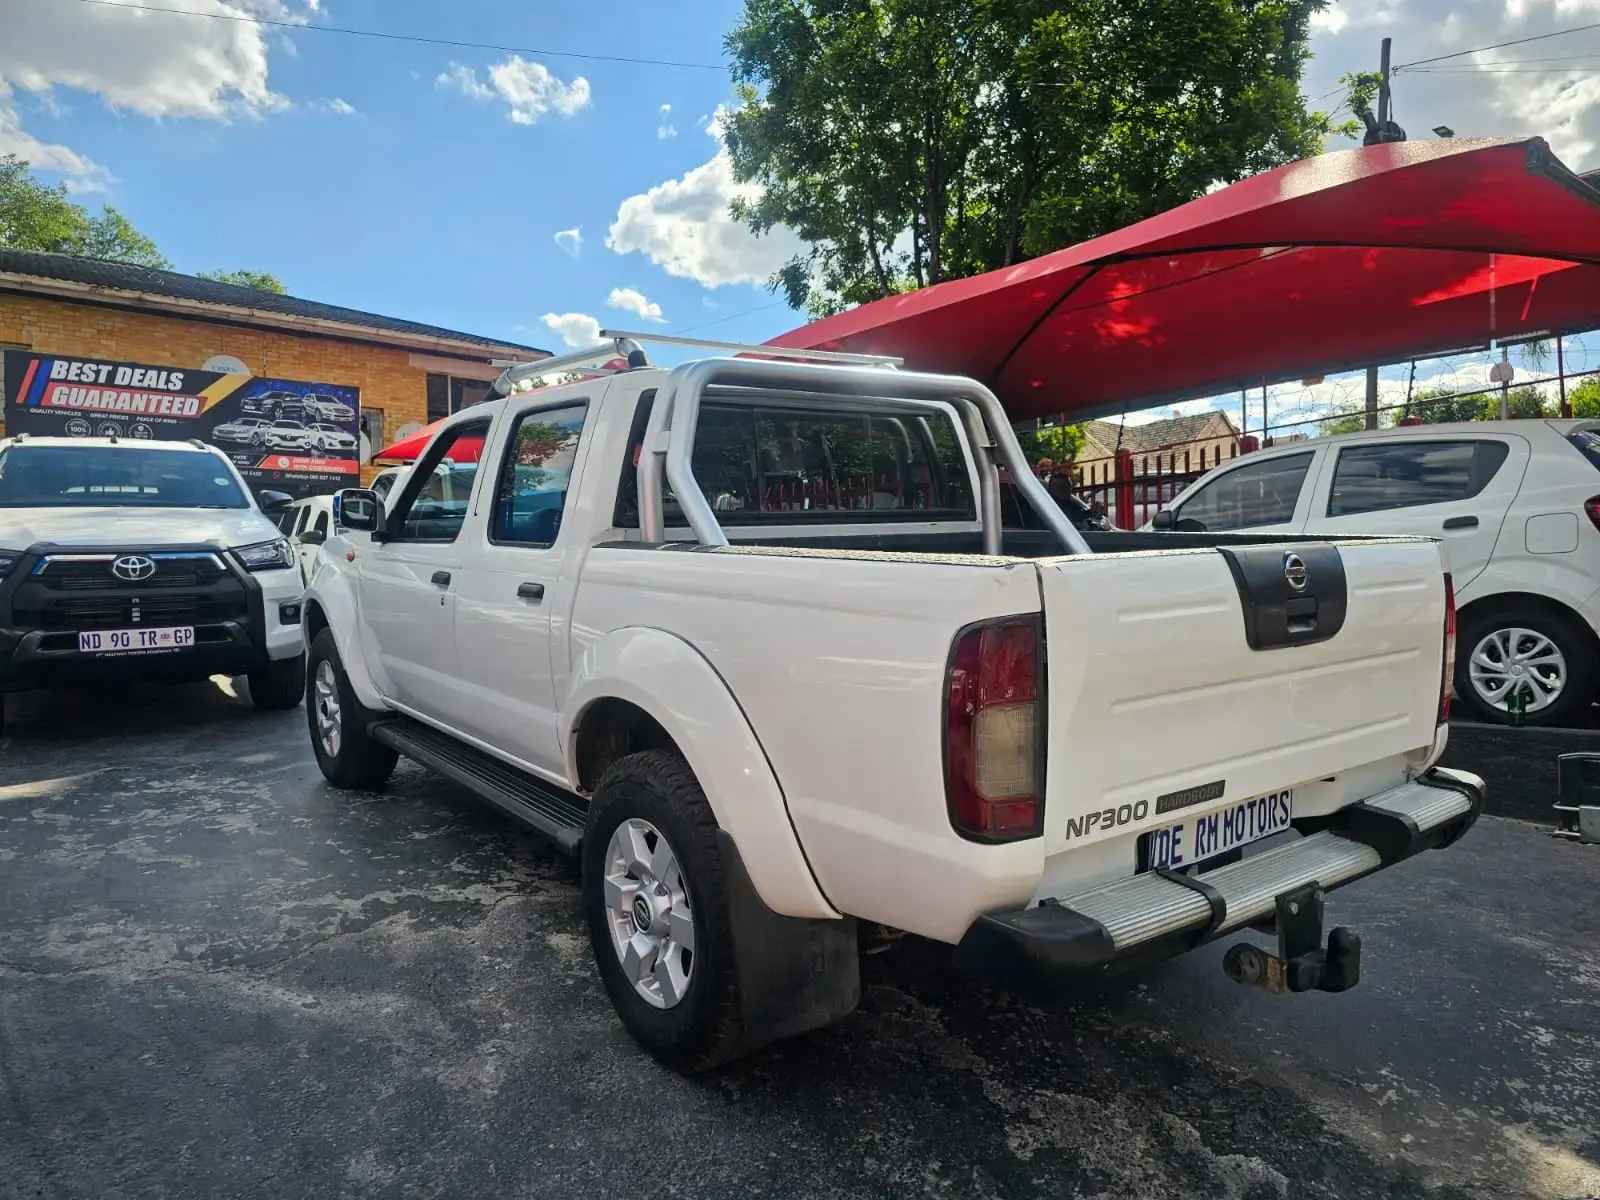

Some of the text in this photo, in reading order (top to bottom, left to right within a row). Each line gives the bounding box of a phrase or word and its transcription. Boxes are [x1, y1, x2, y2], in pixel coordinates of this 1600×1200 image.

[50, 360, 184, 391] BEST DEALS
[30, 407, 82, 417] QUALITY VEHICLES
[51, 386, 200, 416] GUARANTEED
[70, 425, 87, 433] 100%
[81, 628, 192, 650] ND 90 TR GP
[1065, 799, 1148, 840] NP300
[1195, 813, 1218, 857] RM
[1223, 790, 1290, 847] MOTORS
